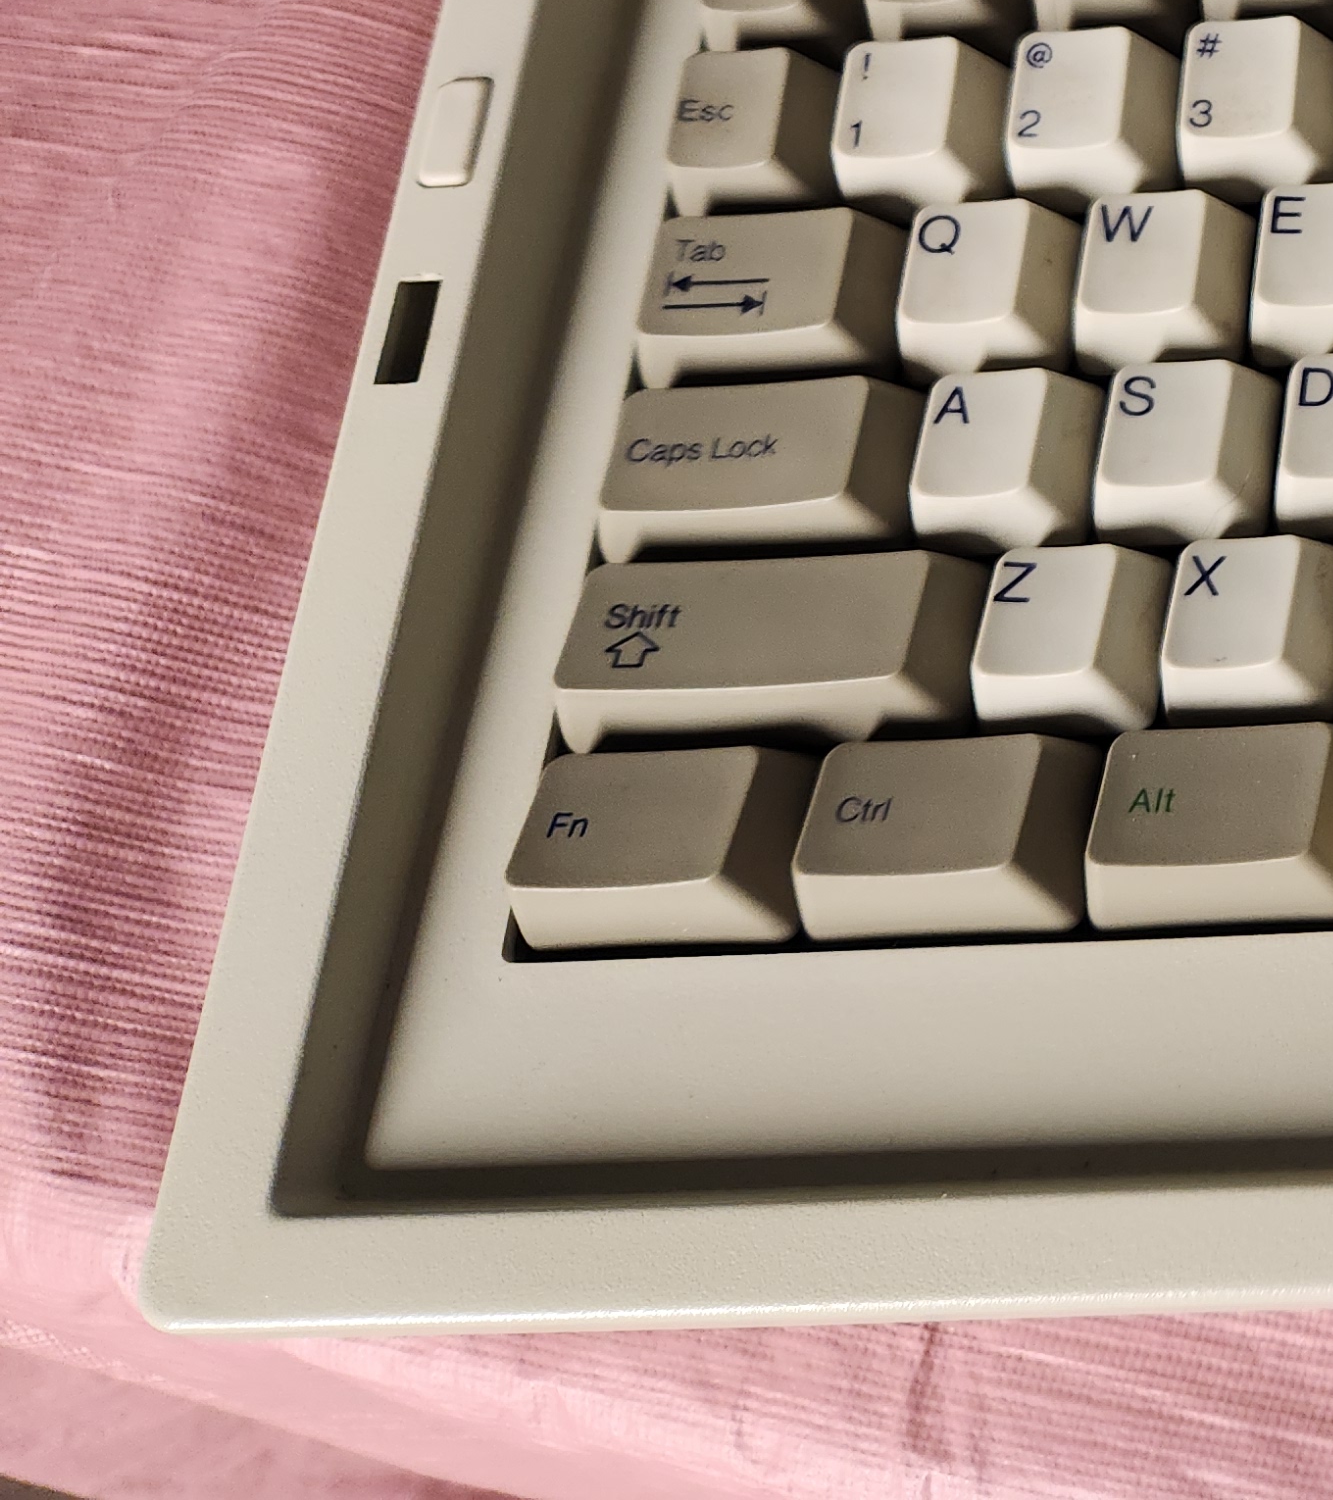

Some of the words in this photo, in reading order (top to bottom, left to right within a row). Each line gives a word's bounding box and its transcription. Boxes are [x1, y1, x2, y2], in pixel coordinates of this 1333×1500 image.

[678, 99, 733, 123] Esc
[1018, 111, 1041, 137] 2
[1189, 100, 1213, 127] 3
[849, 122, 862, 147] 1
[1101, 205, 1153, 243] W
[1270, 196, 1306, 233] E
[918, 215, 961, 255] Q
[675, 239, 726, 263] Tab
[934, 386, 969, 425] A
[1118, 375, 1156, 416] S
[627, 436, 704, 462] Caps
[711, 433, 779, 460] Lock
[993, 562, 1037, 602] Z
[1183, 555, 1227, 596] X
[605, 604, 681, 628] Shift
[835, 797, 890, 823] Ctrl
[1128, 789, 1175, 814] Alt
[547, 813, 588, 839] Fn
